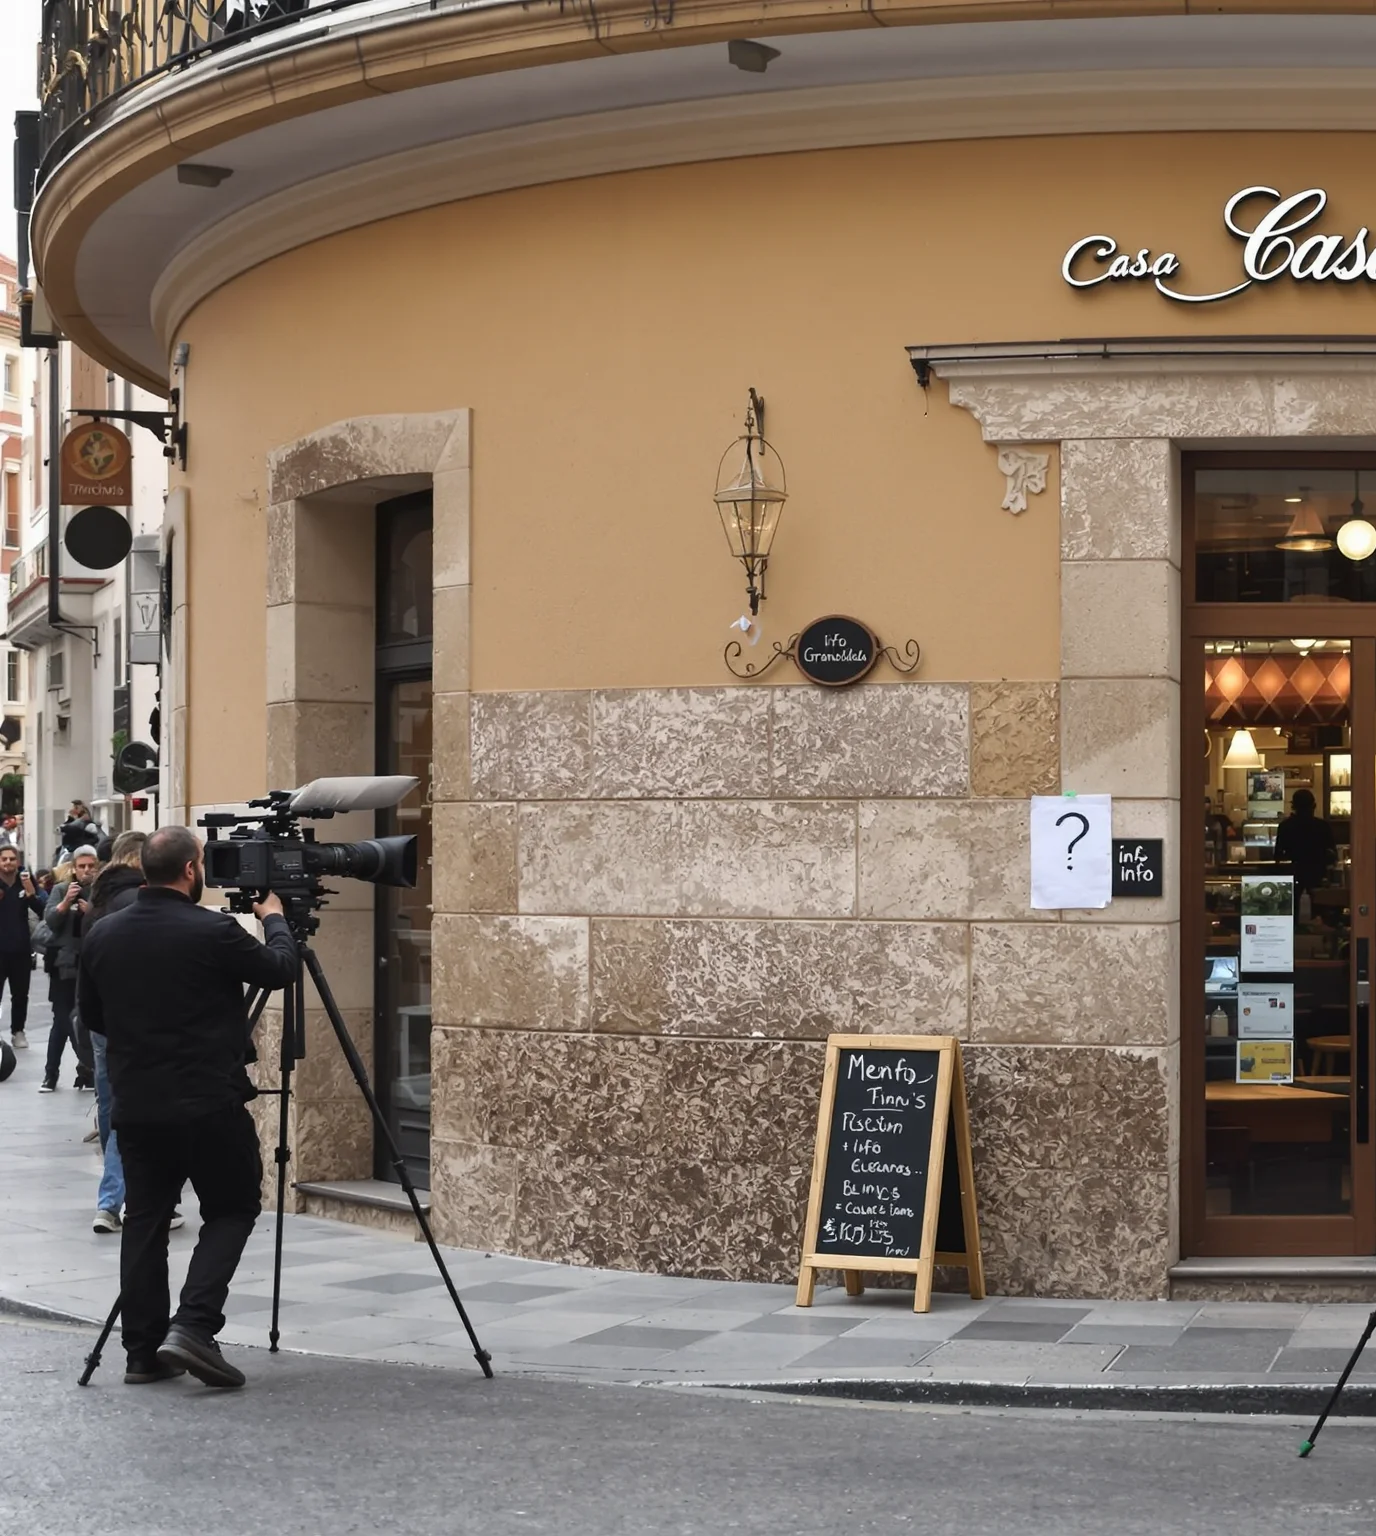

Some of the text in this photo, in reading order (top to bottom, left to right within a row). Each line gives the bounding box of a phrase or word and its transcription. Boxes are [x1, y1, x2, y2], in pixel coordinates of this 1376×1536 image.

[1060, 235, 1180, 287] Casa
[1055, 811, 1090, 871] ?
[1121, 863, 1154, 882] info
